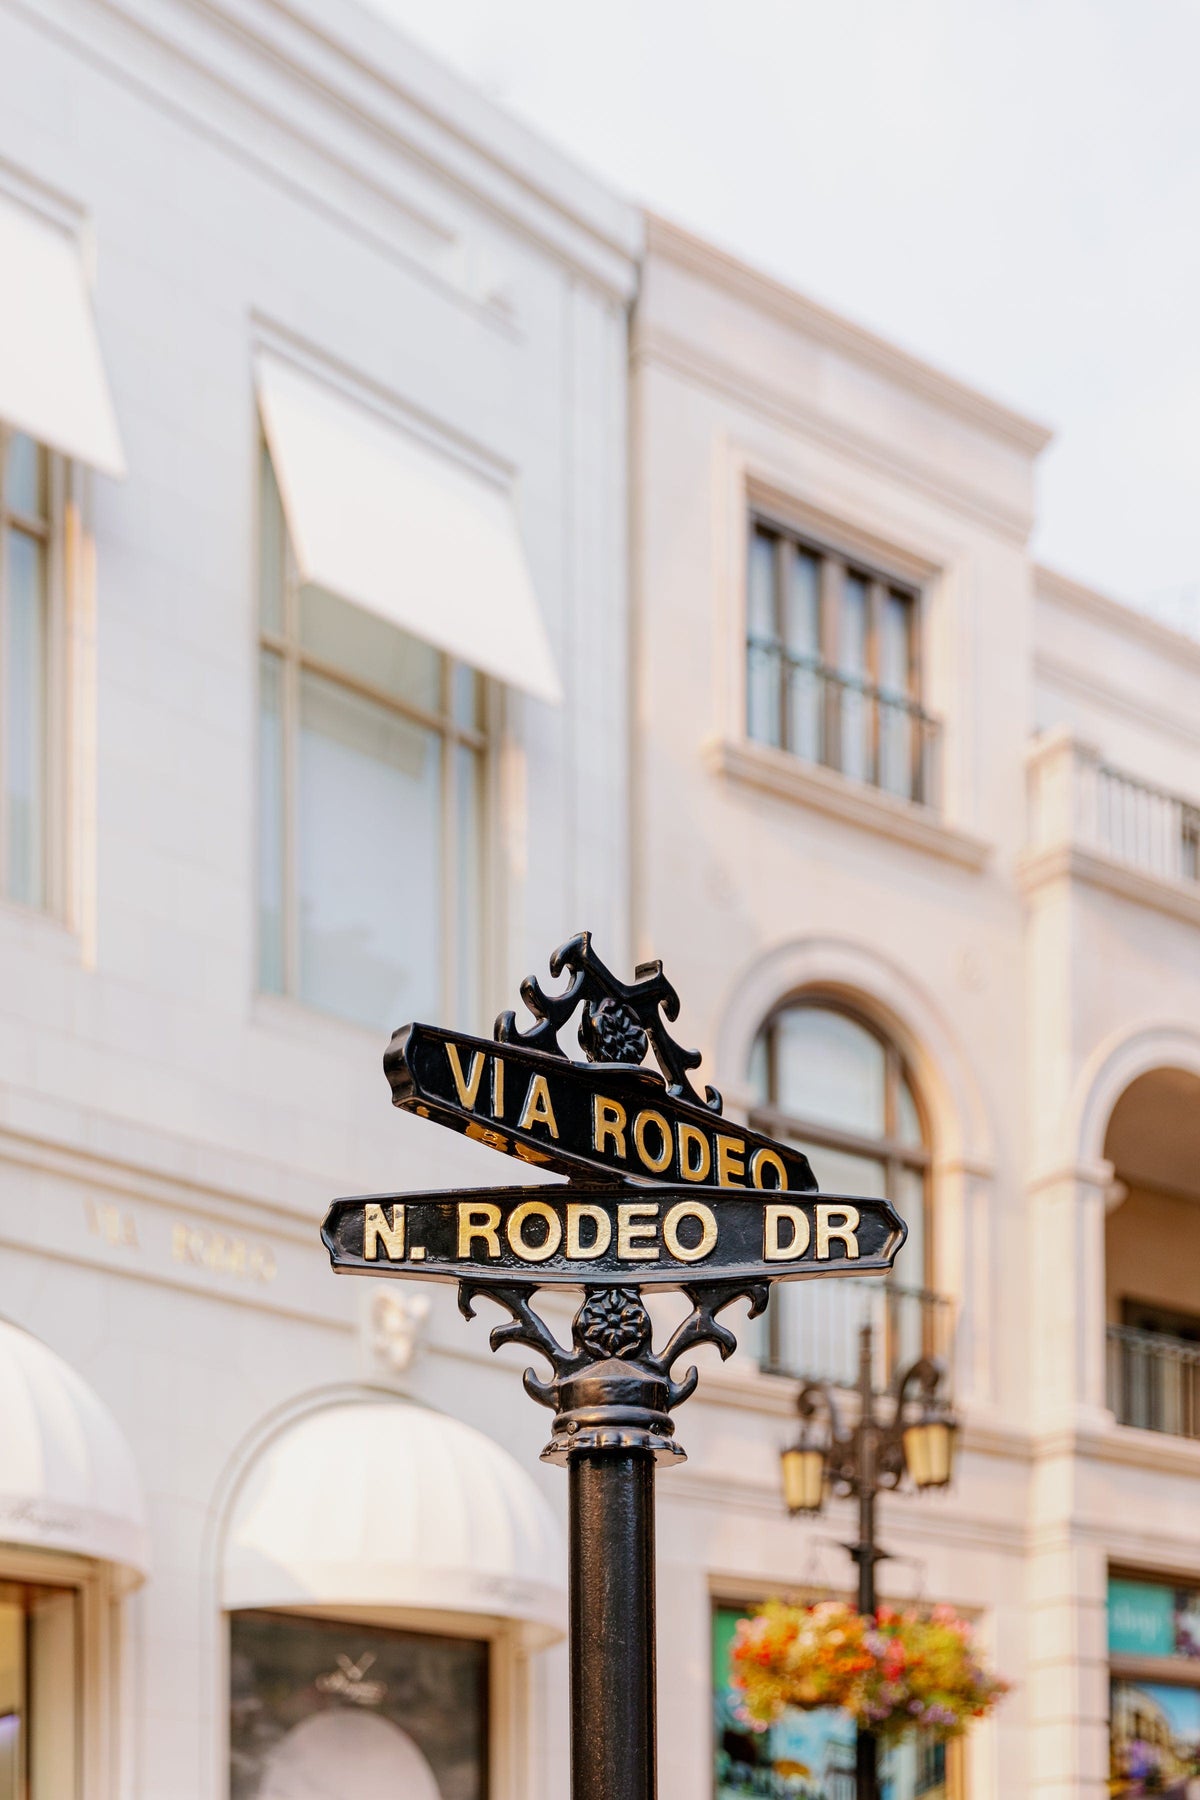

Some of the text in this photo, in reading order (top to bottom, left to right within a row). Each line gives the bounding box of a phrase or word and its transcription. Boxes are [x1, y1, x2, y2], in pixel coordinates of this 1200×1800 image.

[444, 1042, 789, 1191] VIA RODEO
[364, 1201, 861, 1263] N. RODEO DR
